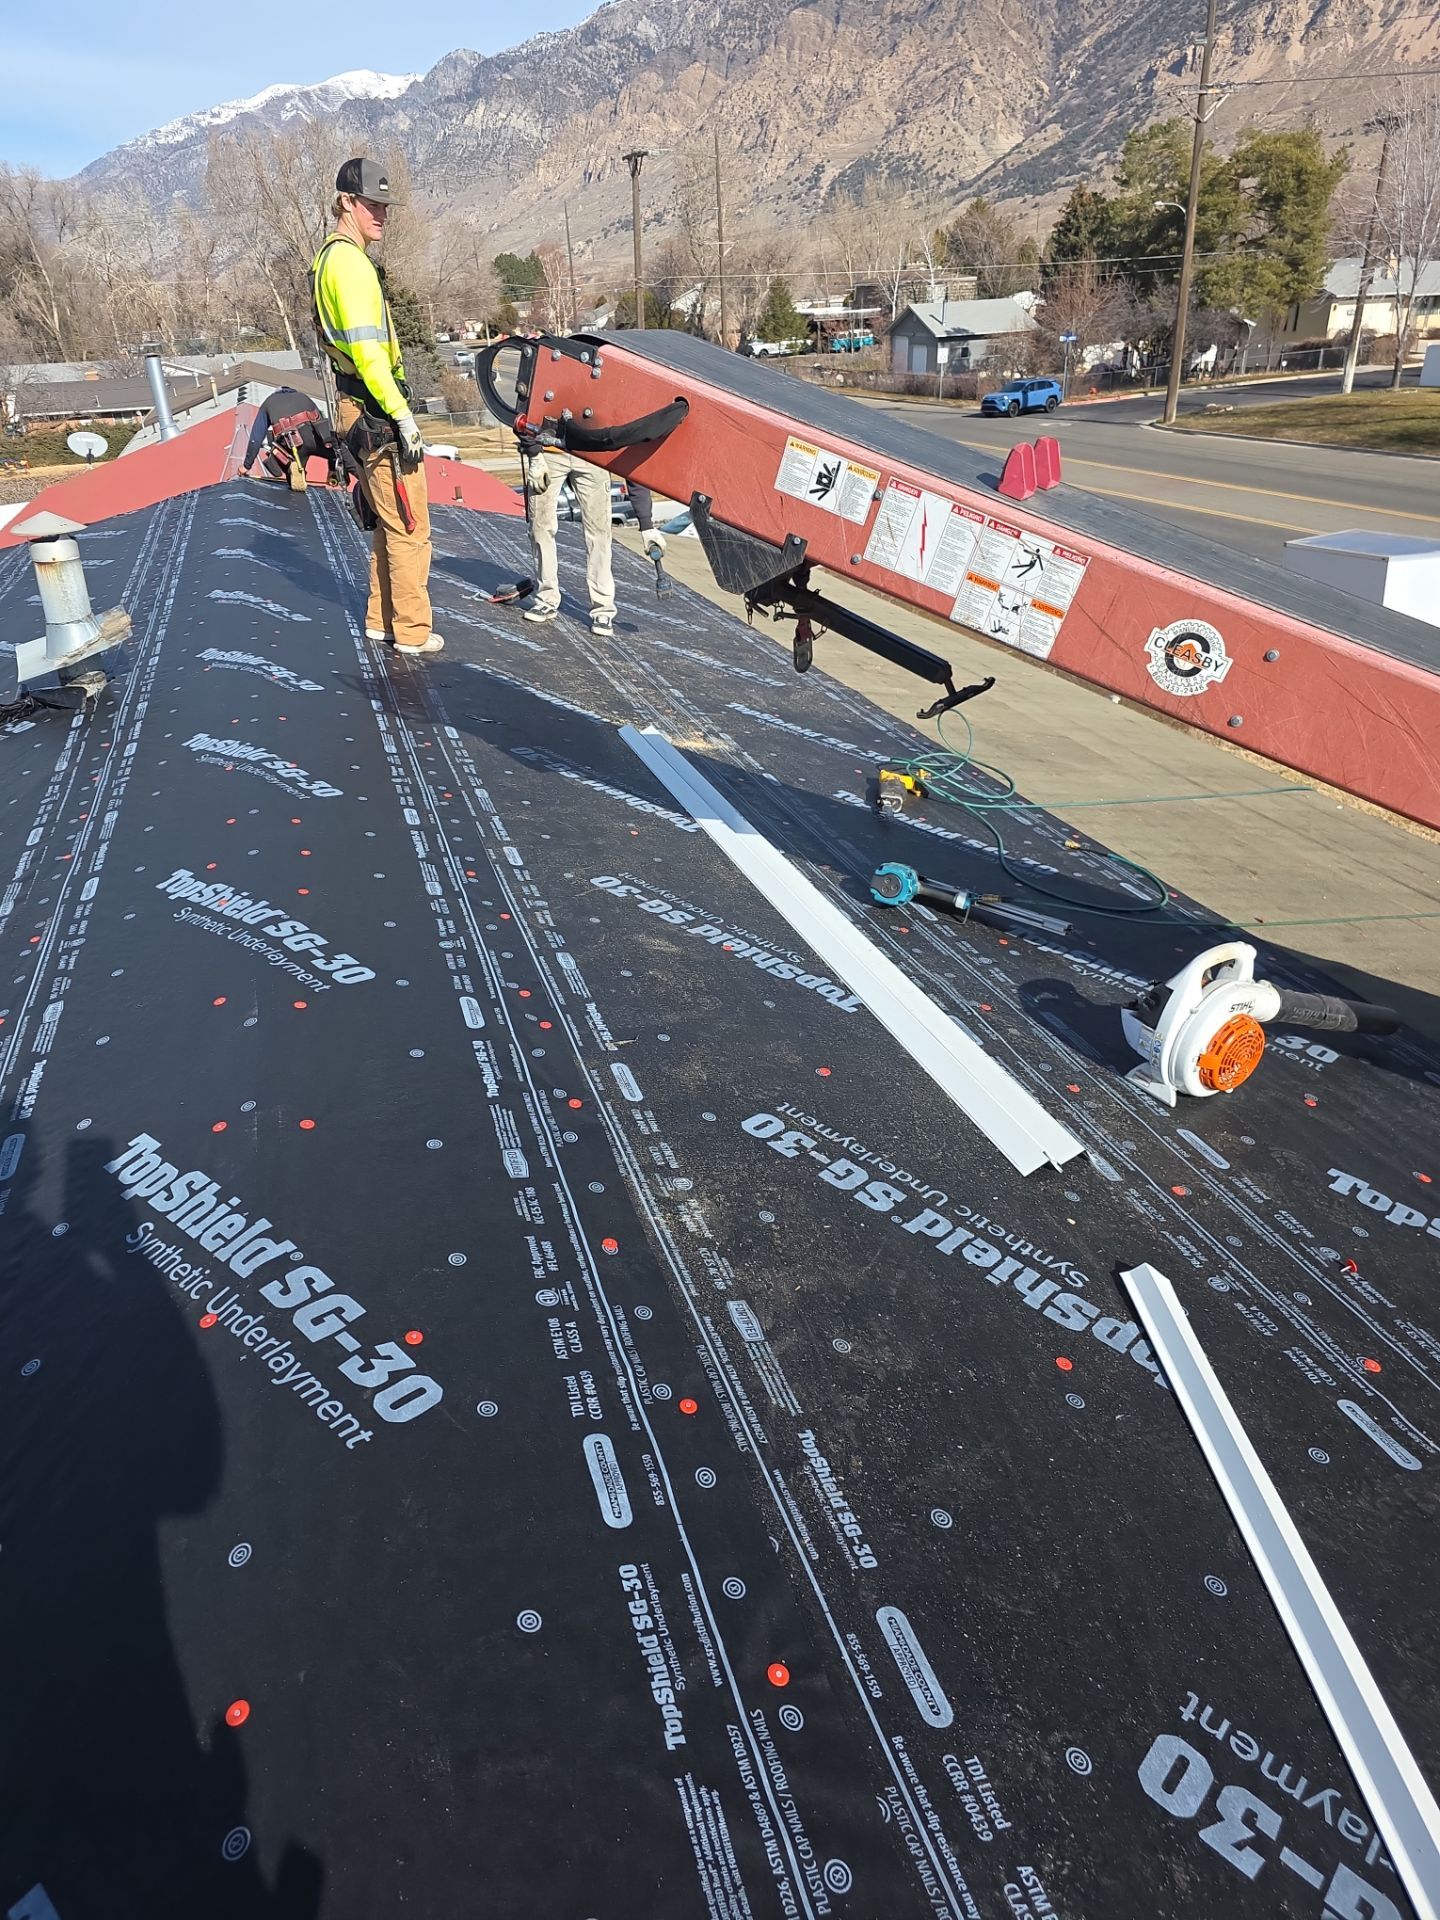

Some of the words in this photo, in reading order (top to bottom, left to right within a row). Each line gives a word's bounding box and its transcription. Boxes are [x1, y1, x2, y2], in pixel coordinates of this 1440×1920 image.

[896, 483, 919, 498] DANGER
[959, 508, 984, 523] PELIGRO
[1154, 636, 1224, 672] CLEASBY
[181, 732, 283, 761] TopShield
[262, 760, 345, 798] SG-30
[589, 875, 696, 926] SG-30
[618, 871, 724, 924] Underlayment
[173, 907, 232, 936] Synthetic
[227, 930, 333, 994] Underlayment
[261, 920, 377, 985] SG-30
[726, 920, 806, 964] Synthetic
[1229, 1000, 1254, 1014] STIHL
[741, 1113, 909, 1214] SG-30
[774, 1101, 951, 1209] Underlayment
[524, 1236, 543, 1264] Approved
[951, 1204, 1090, 1290] Synthetic
[533, 1263, 546, 1278] FBC
[126, 1222, 214, 1301] Synthetic
[205, 1286, 375, 1451] Underlayment
[548, 1318, 562, 1340] E108
[600, 1322, 609, 1340] vary
[733, 1303, 759, 1340] FORTIFIED
[258, 1265, 444, 1424] SG-30
[552, 1335, 569, 1359] ASTM
[566, 1329, 583, 1352] CLASS
[604, 1336, 613, 1353] may
[696, 1345, 713, 1369] PLASTIC
[608, 1351, 623, 1377] resistance
[634, 1362, 646, 1376] CAP
[706, 1364, 718, 1383] CAP
[563, 1376, 581, 1399] Listed
[579, 1371, 597, 1399] #0439
[617, 1373, 627, 1391] slip
[620, 1386, 631, 1406] that
[638, 1374, 654, 1404] PLASTIC
[710, 1330, 723, 1349] ASTM
[725, 1365, 739, 1382] ASTM
[743, 1403, 758, 1426] ASTM
[751, 1421, 769, 1443] D8257
[711, 1378, 727, 1401] NAILS
[570, 1397, 584, 1417] TDI
[587, 1397, 602, 1419] CCRR
[626, 1405, 637, 1425] aware
[721, 1400, 741, 1435] ROOFING
[595, 1441, 608, 1473] COUNTY
[734, 1432, 751, 1452] NAILS
[642, 1454, 665, 1505] 855-569-1550
[798, 1430, 847, 1509] TopShield
[837, 1507, 876, 1568] SG-30
[823, 1506, 858, 1570] Underlayment
[619, 1564, 653, 1634] SG-30
[640, 1563, 669, 1636] Underlayment
[681, 1573, 722, 1687] www.srsdistribution.com
[663, 1639, 686, 1690] Synthetic
[846, 1633, 882, 1698] 855-569-1550
[888, 1618, 918, 1672] MIAMI-DADE
[914, 1670, 938, 1715] COUNTY
[893, 1646, 916, 1686] APPROVED
[637, 1634, 686, 1750] TopShield
[727, 1725, 747, 1758] D8257
[750, 1709, 770, 1740] NAILS
[674, 1778, 683, 1788] of
[737, 1758, 757, 1789] ASTM
[761, 1742, 789, 1790] ROOFING
[678, 1787, 693, 1829] component
[685, 1772, 703, 1821] requirements,
[699, 1785, 711, 1806] apply.
[749, 1791, 760, 1800] &
[943, 1755, 969, 1792] CCRR
[960, 1794, 993, 1841] #0439
[965, 1755, 987, 1781] TDI
[977, 1783, 1012, 1829] Listed
[705, 1807, 721, 1850] restrictions
[753, 1803, 774, 1838] D4869
[782, 1800, 804, 1833] NAILS
[892, 1736, 906, 1753] Be
[899, 1752, 919, 1784] aware
[914, 1785, 932, 1809] that
[925, 1811, 942, 1830] slip
[935, 1832, 967, 1891] resistance
[962, 1893, 981, 1919] may
[691, 1836, 698, 1846] as
[696, 1822, 713, 1860] Additional
[765, 1839, 785, 1874] ASTM
[795, 1835, 813, 1859] CAP
[885, 1786, 913, 1835] PLASTIC
[905, 1834, 924, 1862] CAP
[916, 1859, 940, 1896] NAILS
[697, 1858, 705, 1869] for
[715, 1851, 725, 1868] and
[732, 1867, 742, 1886] visit
[699, 1870, 715, 1905] qualified
[721, 1866, 733, 1893] criteria
[777, 1877, 797, 1915] D226,
[803, 1860, 831, 1914] PLASTIC
[1017, 1867, 1052, 1912] ASTM
